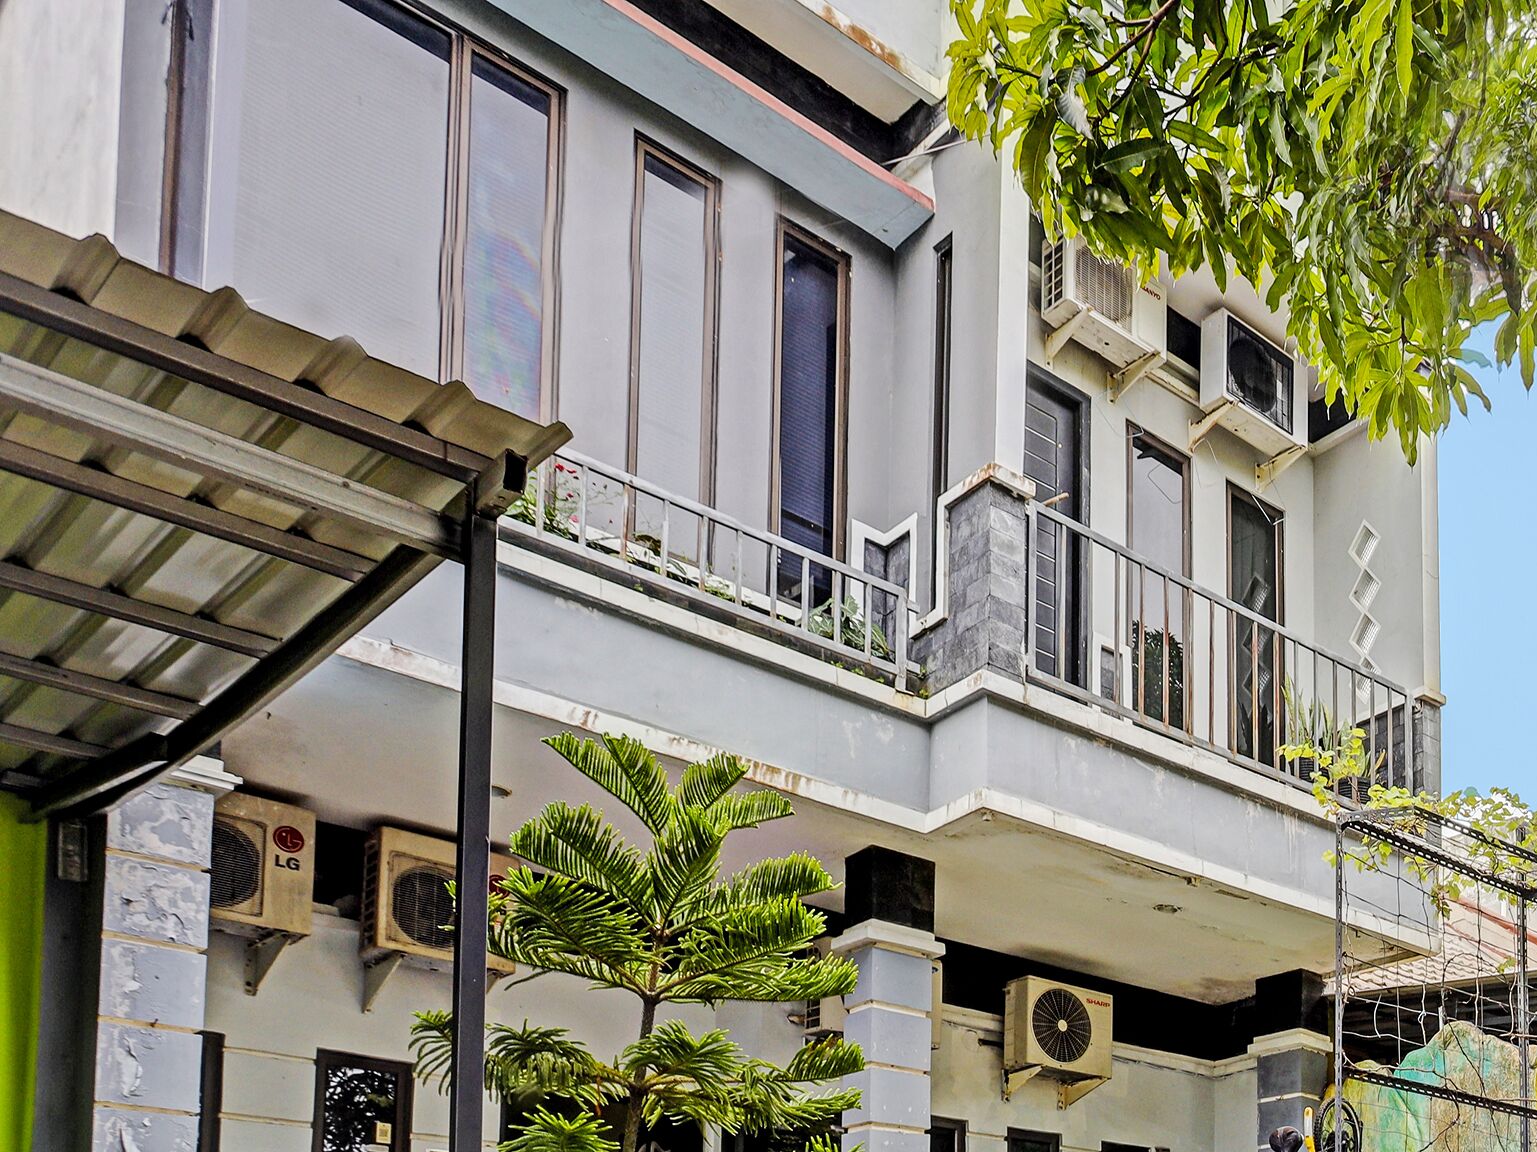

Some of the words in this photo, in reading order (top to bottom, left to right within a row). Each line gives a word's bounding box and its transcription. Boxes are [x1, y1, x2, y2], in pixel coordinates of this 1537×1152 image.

[1140, 285, 1161, 300] ANYO
[274, 854, 301, 871] LG
[1086, 998, 1111, 1008] SHARP
